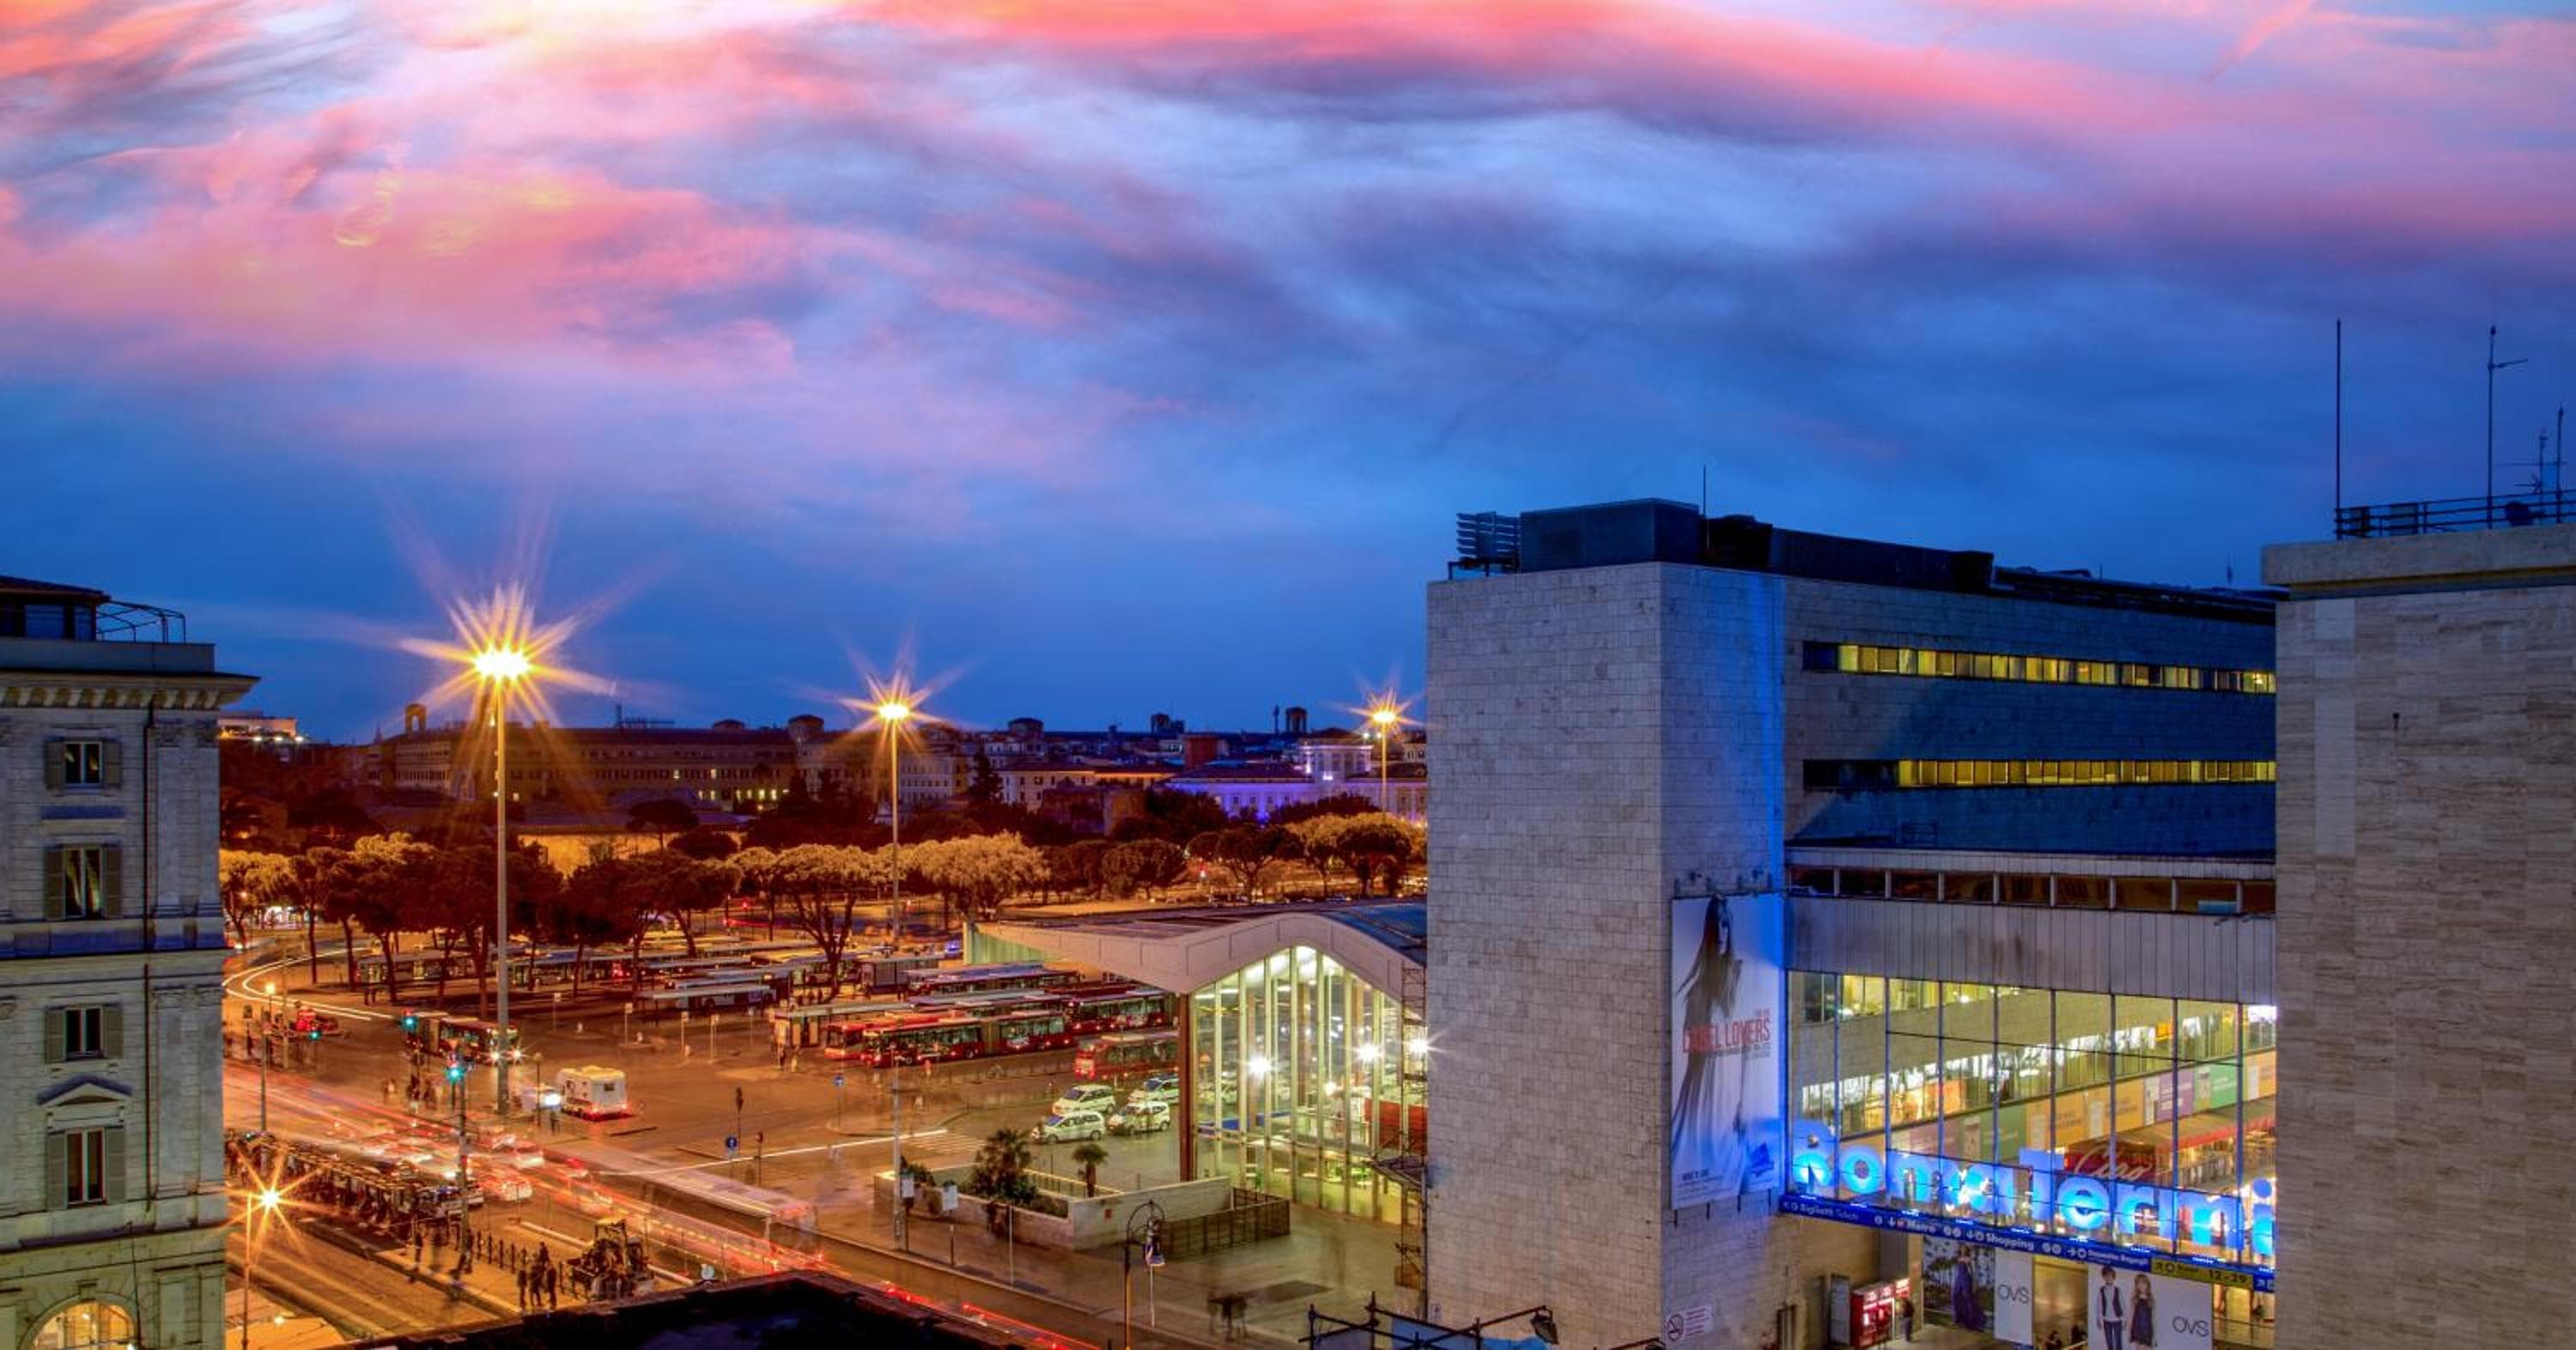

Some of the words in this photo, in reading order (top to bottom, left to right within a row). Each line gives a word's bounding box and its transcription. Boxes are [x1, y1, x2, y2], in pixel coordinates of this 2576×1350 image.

[1725, 1017, 1771, 1047] LOVERS
[1907, 1219, 1937, 1234] Metro
[1985, 1231, 2035, 1251] Shopping
[1998, 1284, 2029, 1304] OVS
[2172, 1316, 2210, 1337] OVS
